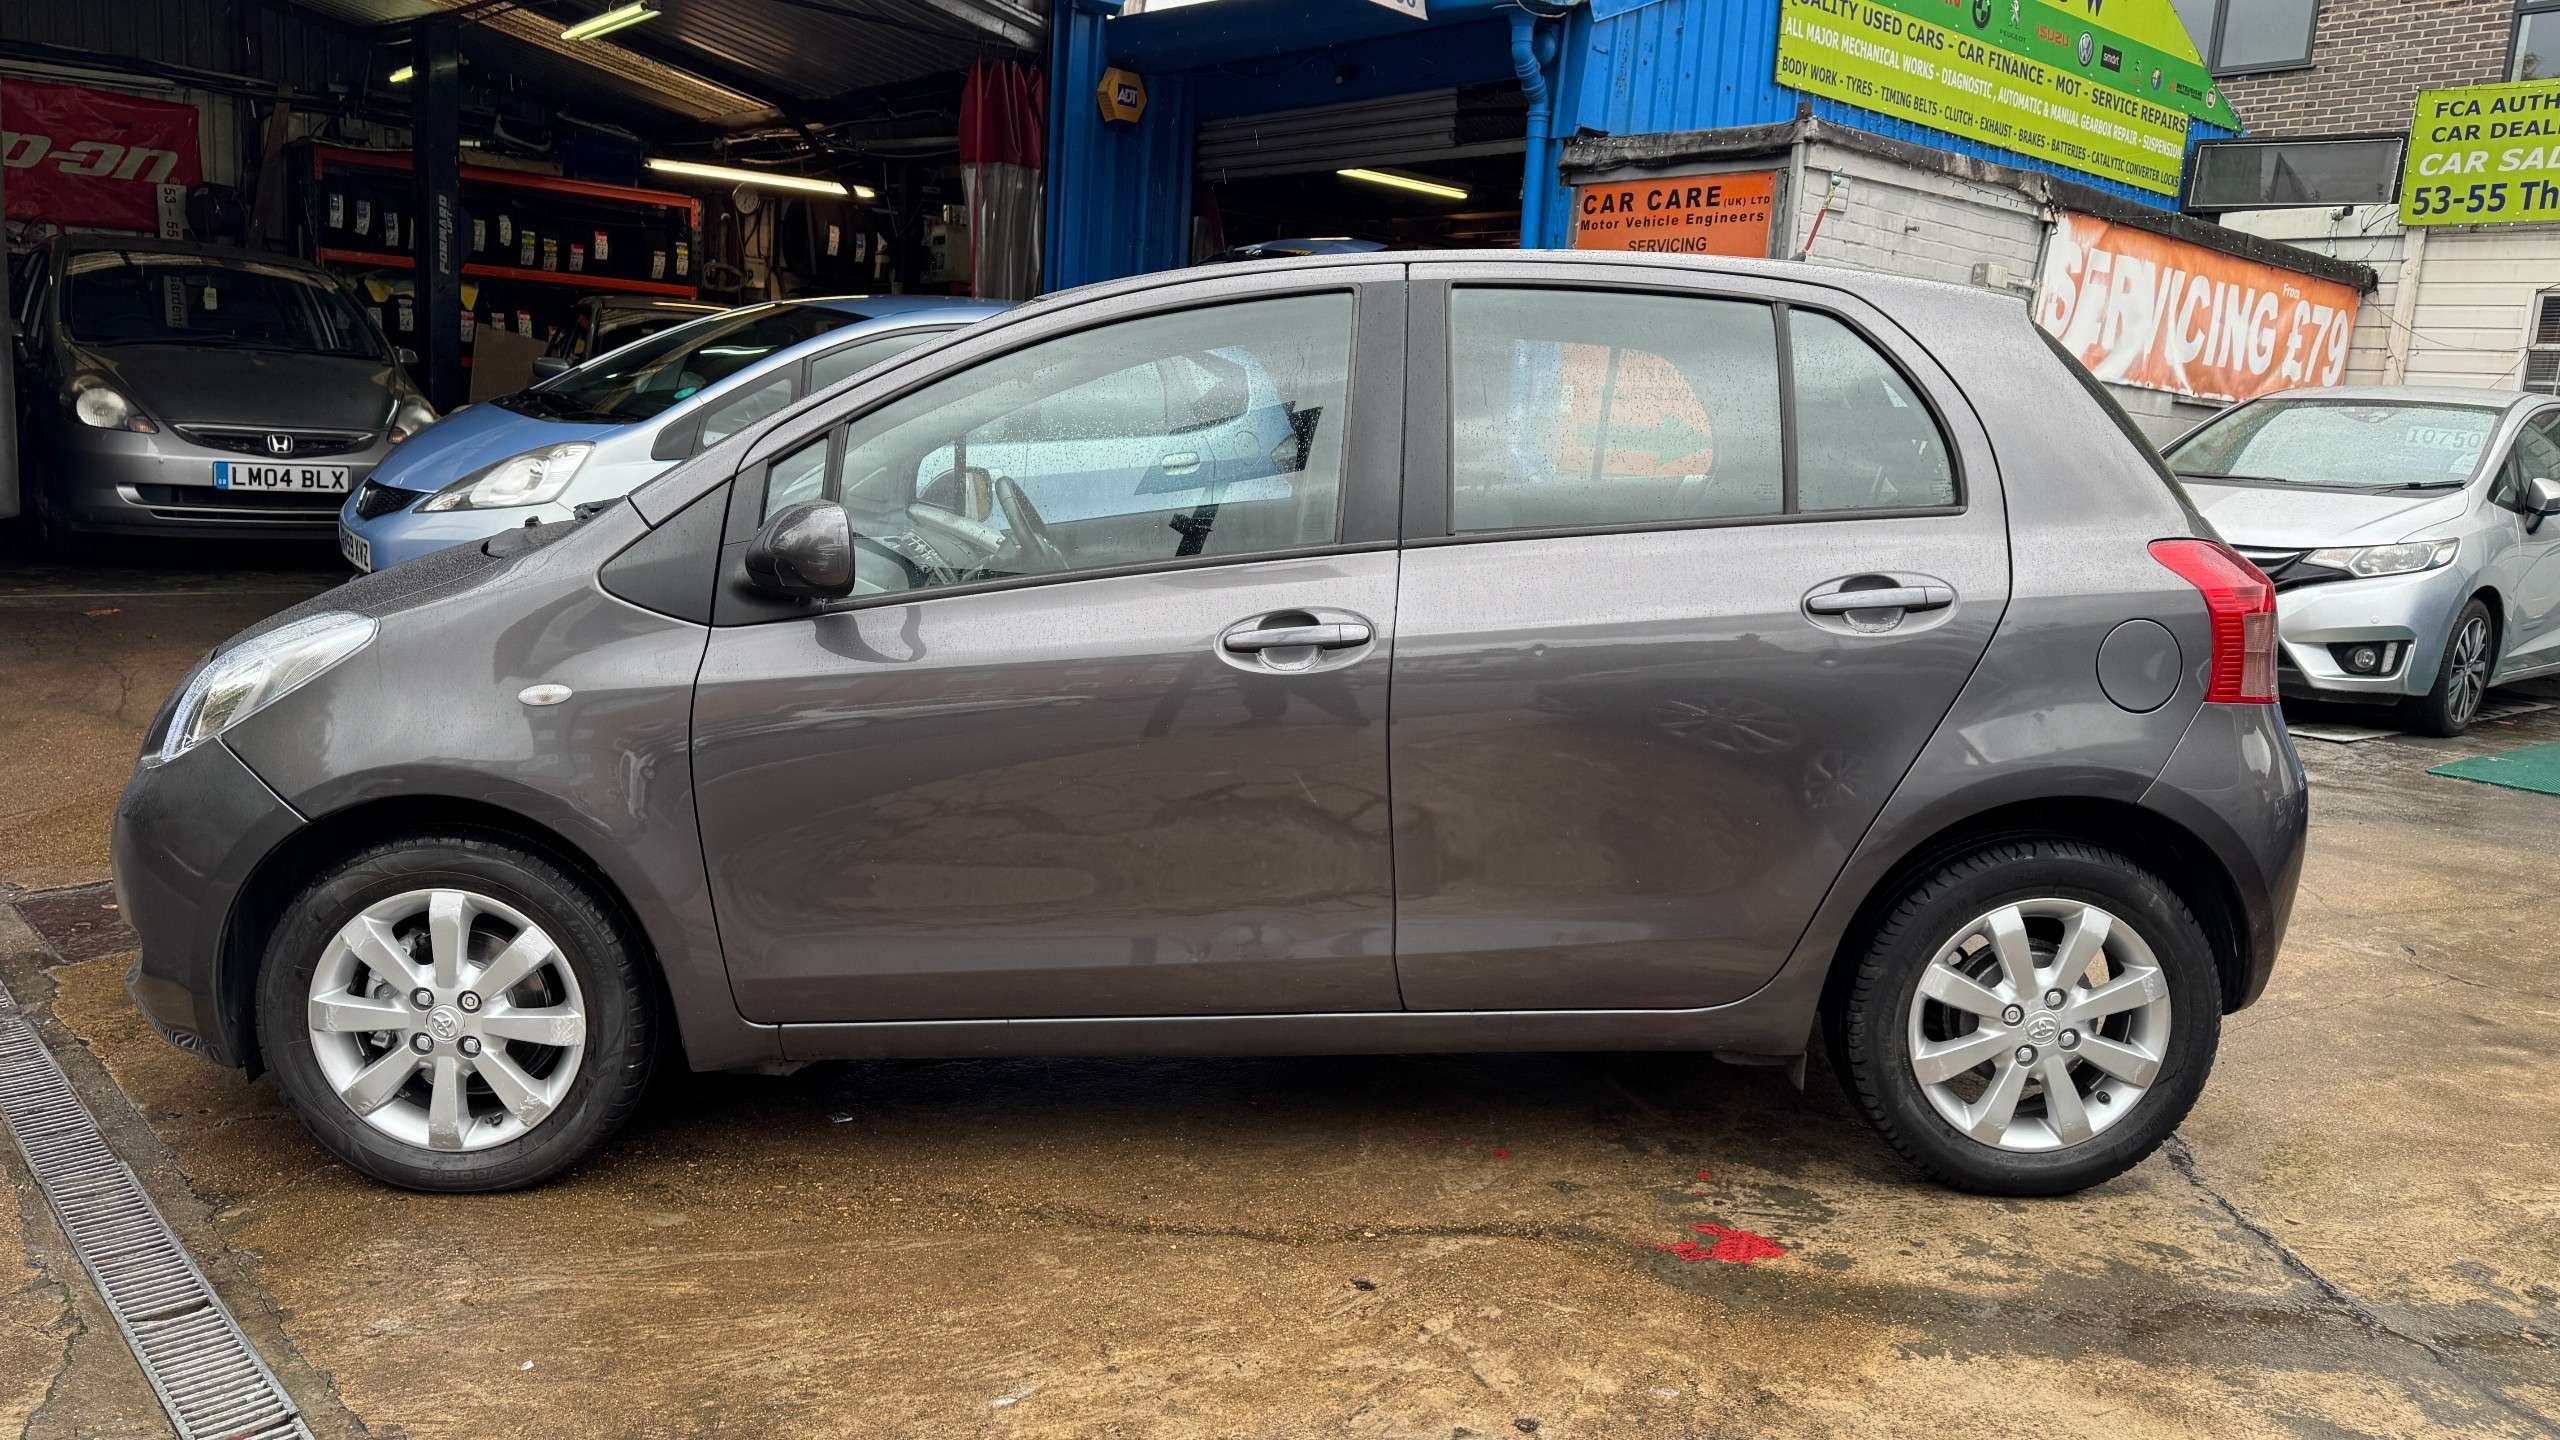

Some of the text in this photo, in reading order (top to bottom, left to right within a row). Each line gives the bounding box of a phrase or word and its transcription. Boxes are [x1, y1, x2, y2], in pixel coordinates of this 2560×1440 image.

[1791, 0, 1859, 20] LITY
[1863, 5, 1903, 36] USED
[1907, 22, 1945, 51] CARS
[1958, 40, 1985, 66] CAR
[1988, 50, 2045, 86] FINANCE
[2056, 75, 2082, 98] MOT
[2091, 88, 2138, 119] SERVICE
[2142, 104, 2187, 135] REPAIRS
[1118, 87, 1137, 105] ADT
[1785, 16, 1804, 39] ALL
[1807, 22, 1840, 51] MAJOR
[1841, 35, 1900, 70] MECHANICAL
[1903, 55, 1935, 81] WORKS
[1941, 67, 1993, 99] DIAGNOSTIC
[1999, 86, 2043, 117] AUTOMATIC
[2043, 106, 2050, 118] &
[2051, 103, 2079, 128] MANUAL
[2080, 115, 2112, 137] GEARBOX
[2112, 125, 2137, 146] REPAIR
[2142, 136, 2184, 160] SUSPENSION
[1782, 56, 1809, 78] BODY
[1811, 65, 1838, 87] WORK
[1846, 75, 1873, 97] TYRES
[1881, 85, 1911, 108] TIMING
[1913, 94, 1938, 117] BELTS
[1944, 105, 1974, 128] CLUTCH
[1980, 116, 2013, 139] EXHAUST
[2018, 128, 2046, 149] BRAKES
[2051, 138, 2087, 161] BATTERIES
[2091, 151, 2125, 172] CATALYTIC
[2125, 160, 2161, 183] CONVERTER
[2161, 171, 2179, 188] LOCKS
[2435, 99, 2481, 118] FCA
[2431, 119, 2560, 143] CAR DEAL
[2418, 150, 2489, 177] CAR
[1583, 185, 1771, 215] CAR CARE (UK) LTD
[2412, 179, 2560, 216] 53-55 Th
[438, 194, 449, 274] FORWARD
[1580, 211, 1765, 231] Motor Vehicle Engineers
[1628, 237, 1708, 253] SERVICING
[2281, 282, 2301, 299] From
[2045, 247, 2279, 376] SERVICING
[2281, 299, 2349, 387] £79
[2407, 429, 2481, 449] 10750
[231, 466, 345, 489] LM04 BLX
